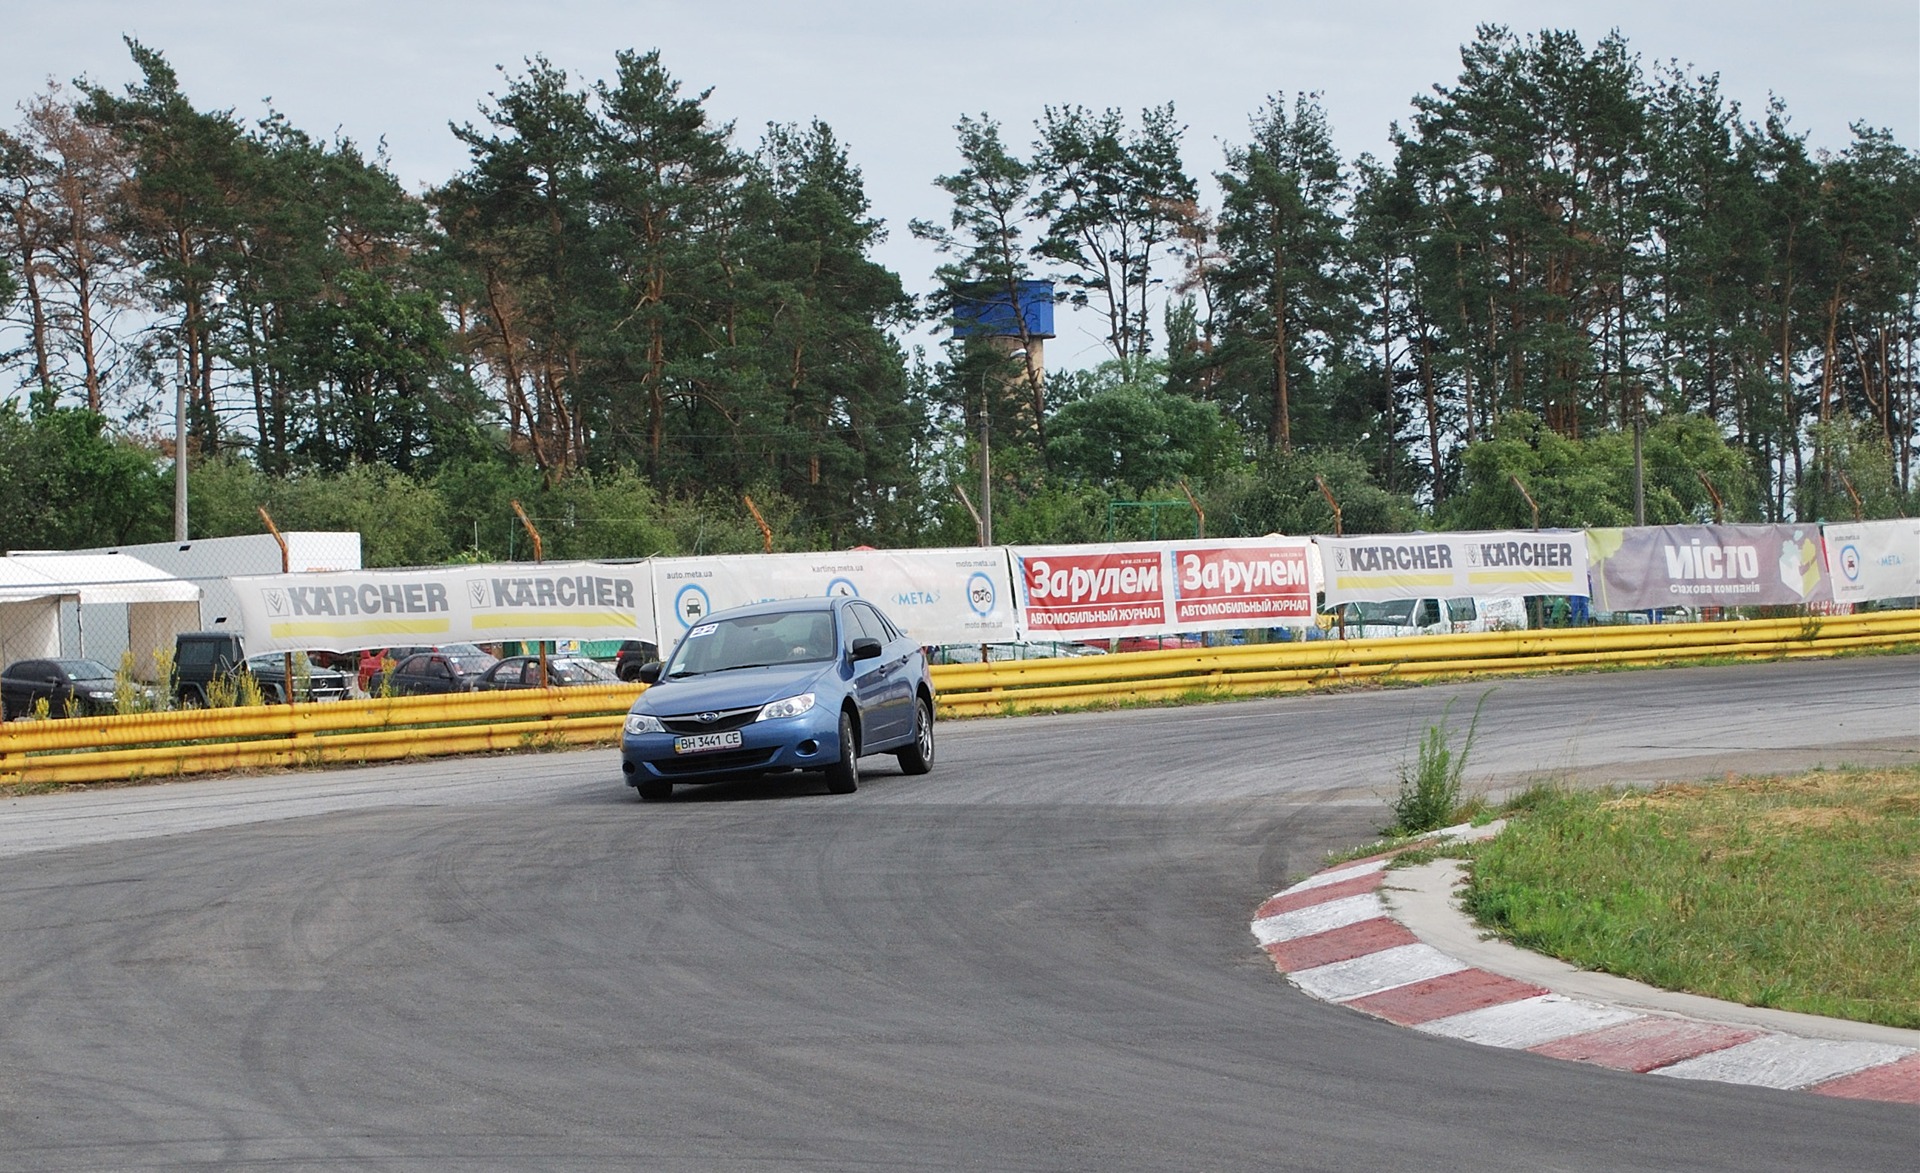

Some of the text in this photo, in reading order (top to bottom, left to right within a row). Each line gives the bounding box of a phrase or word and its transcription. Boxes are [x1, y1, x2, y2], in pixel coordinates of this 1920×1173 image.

[1349, 544, 1453, 571] KÄRCHER
[1480, 541, 1572, 567] KÄRCHER
[666, 571, 713, 580] auto.meta.ua
[811, 565, 864, 574] karting.meta.ua
[287, 582, 449, 616] KÄRCHER
[491, 575, 635, 608] KÄRCHER
[1031, 606, 1161, 625] АВТОМОБИЛЬНЫЙ ЖУРНАЛ
[1181, 599, 1309, 617] АВТОМОБИЛЬНЫЙ ЖУРНАЛ
[698, 735, 721, 747] 3441
[725, 732, 740, 744] CE
